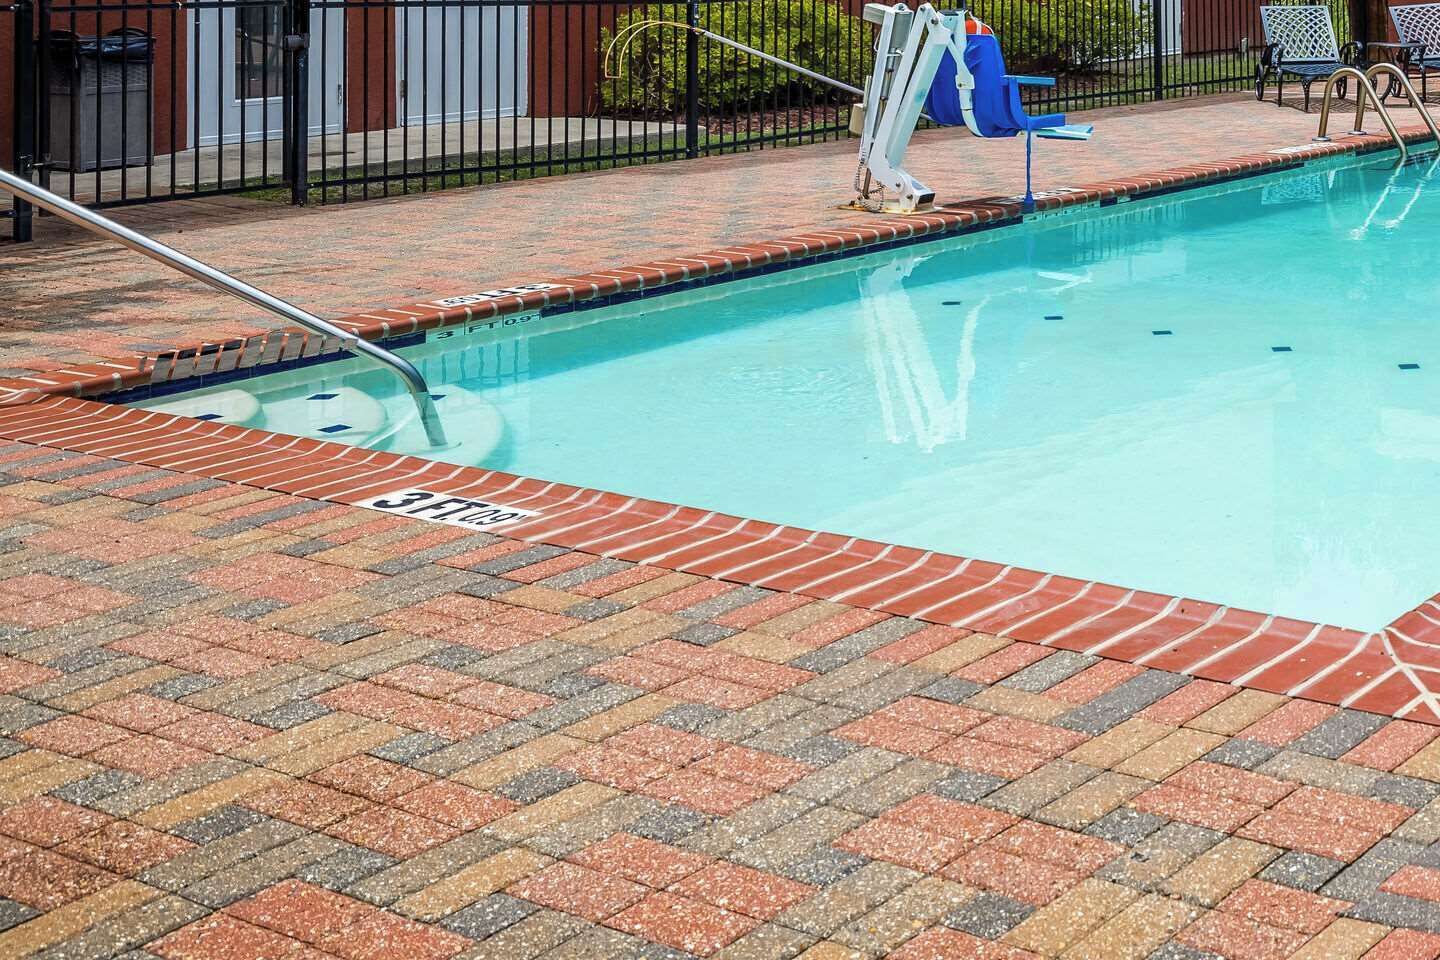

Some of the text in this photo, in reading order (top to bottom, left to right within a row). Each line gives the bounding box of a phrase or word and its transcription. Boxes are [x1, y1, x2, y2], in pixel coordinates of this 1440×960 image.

[436, 330, 454, 340] 3
[468, 321, 500, 334] FT
[372, 491, 435, 509] 3
